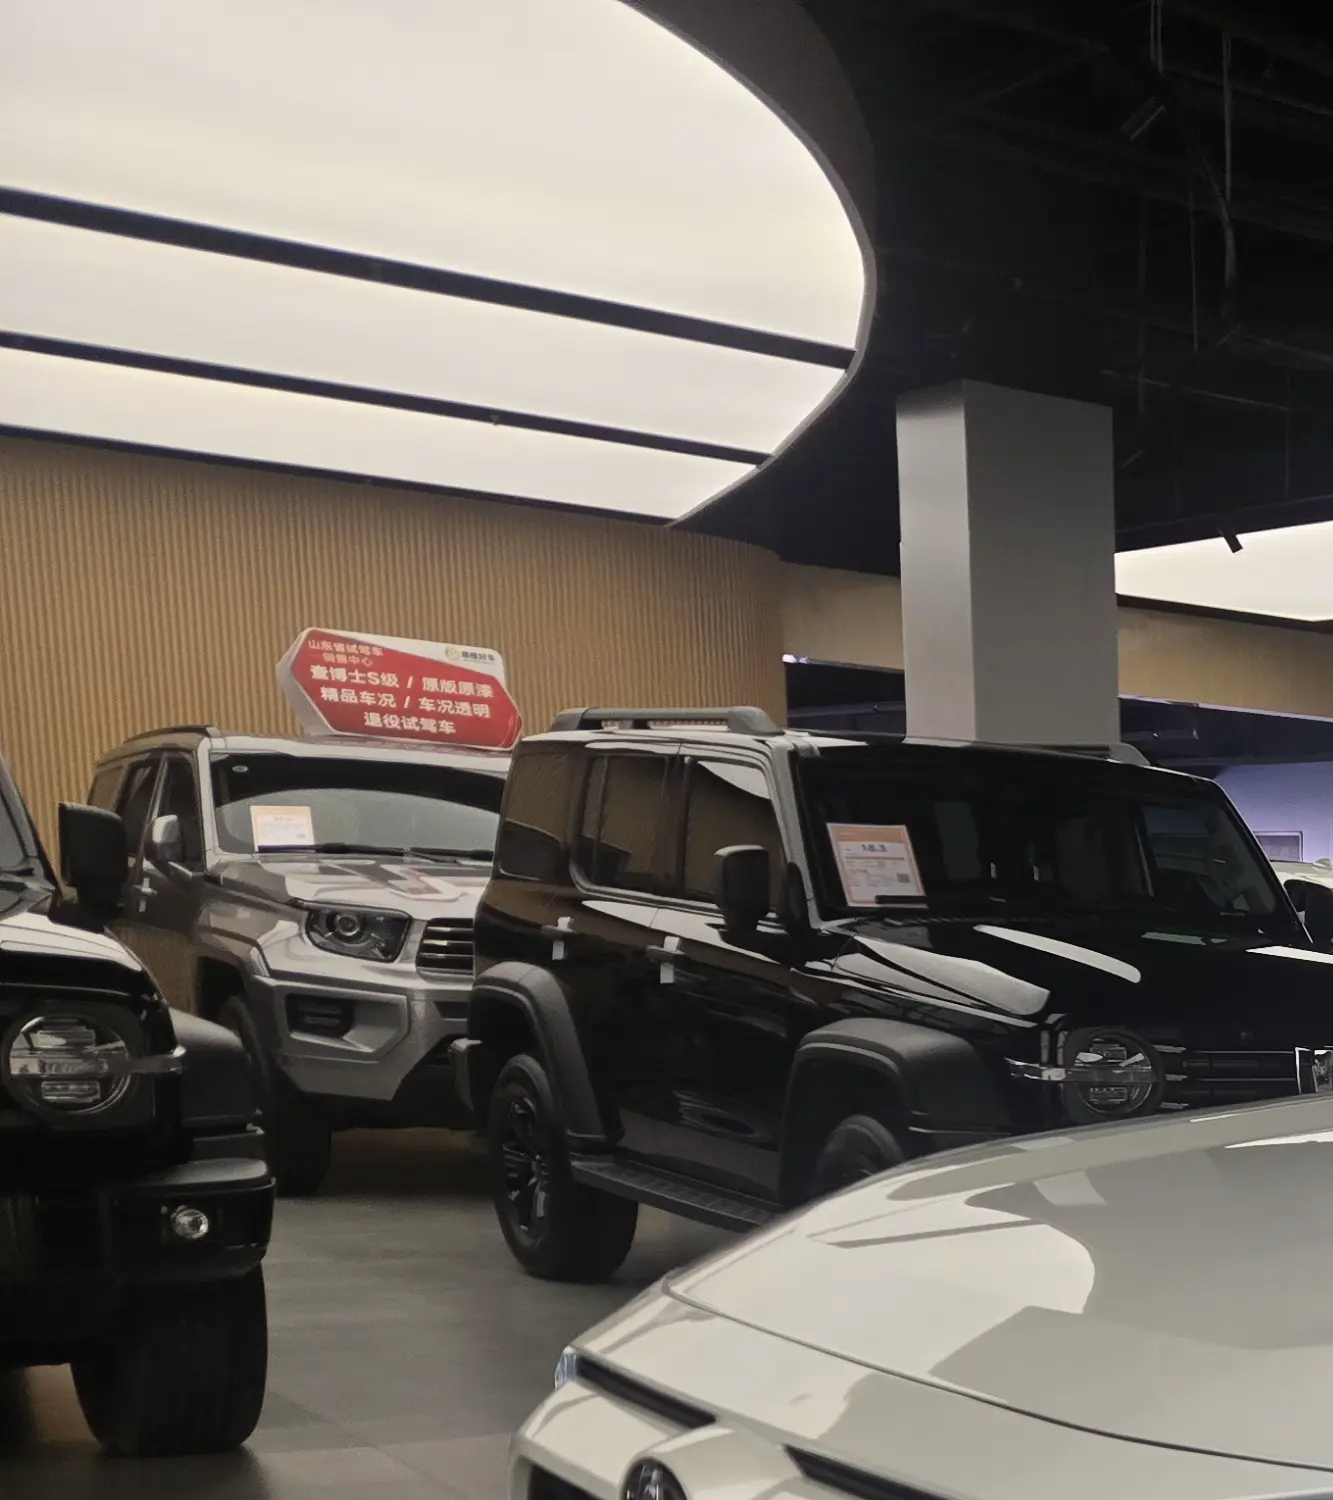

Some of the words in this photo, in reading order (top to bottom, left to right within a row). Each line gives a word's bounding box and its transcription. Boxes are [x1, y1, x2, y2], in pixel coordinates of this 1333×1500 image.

[320, 686, 397, 709] 精品车况
[418, 696, 492, 719] 车况透明
[363, 711, 456, 735] 退役试驾车
